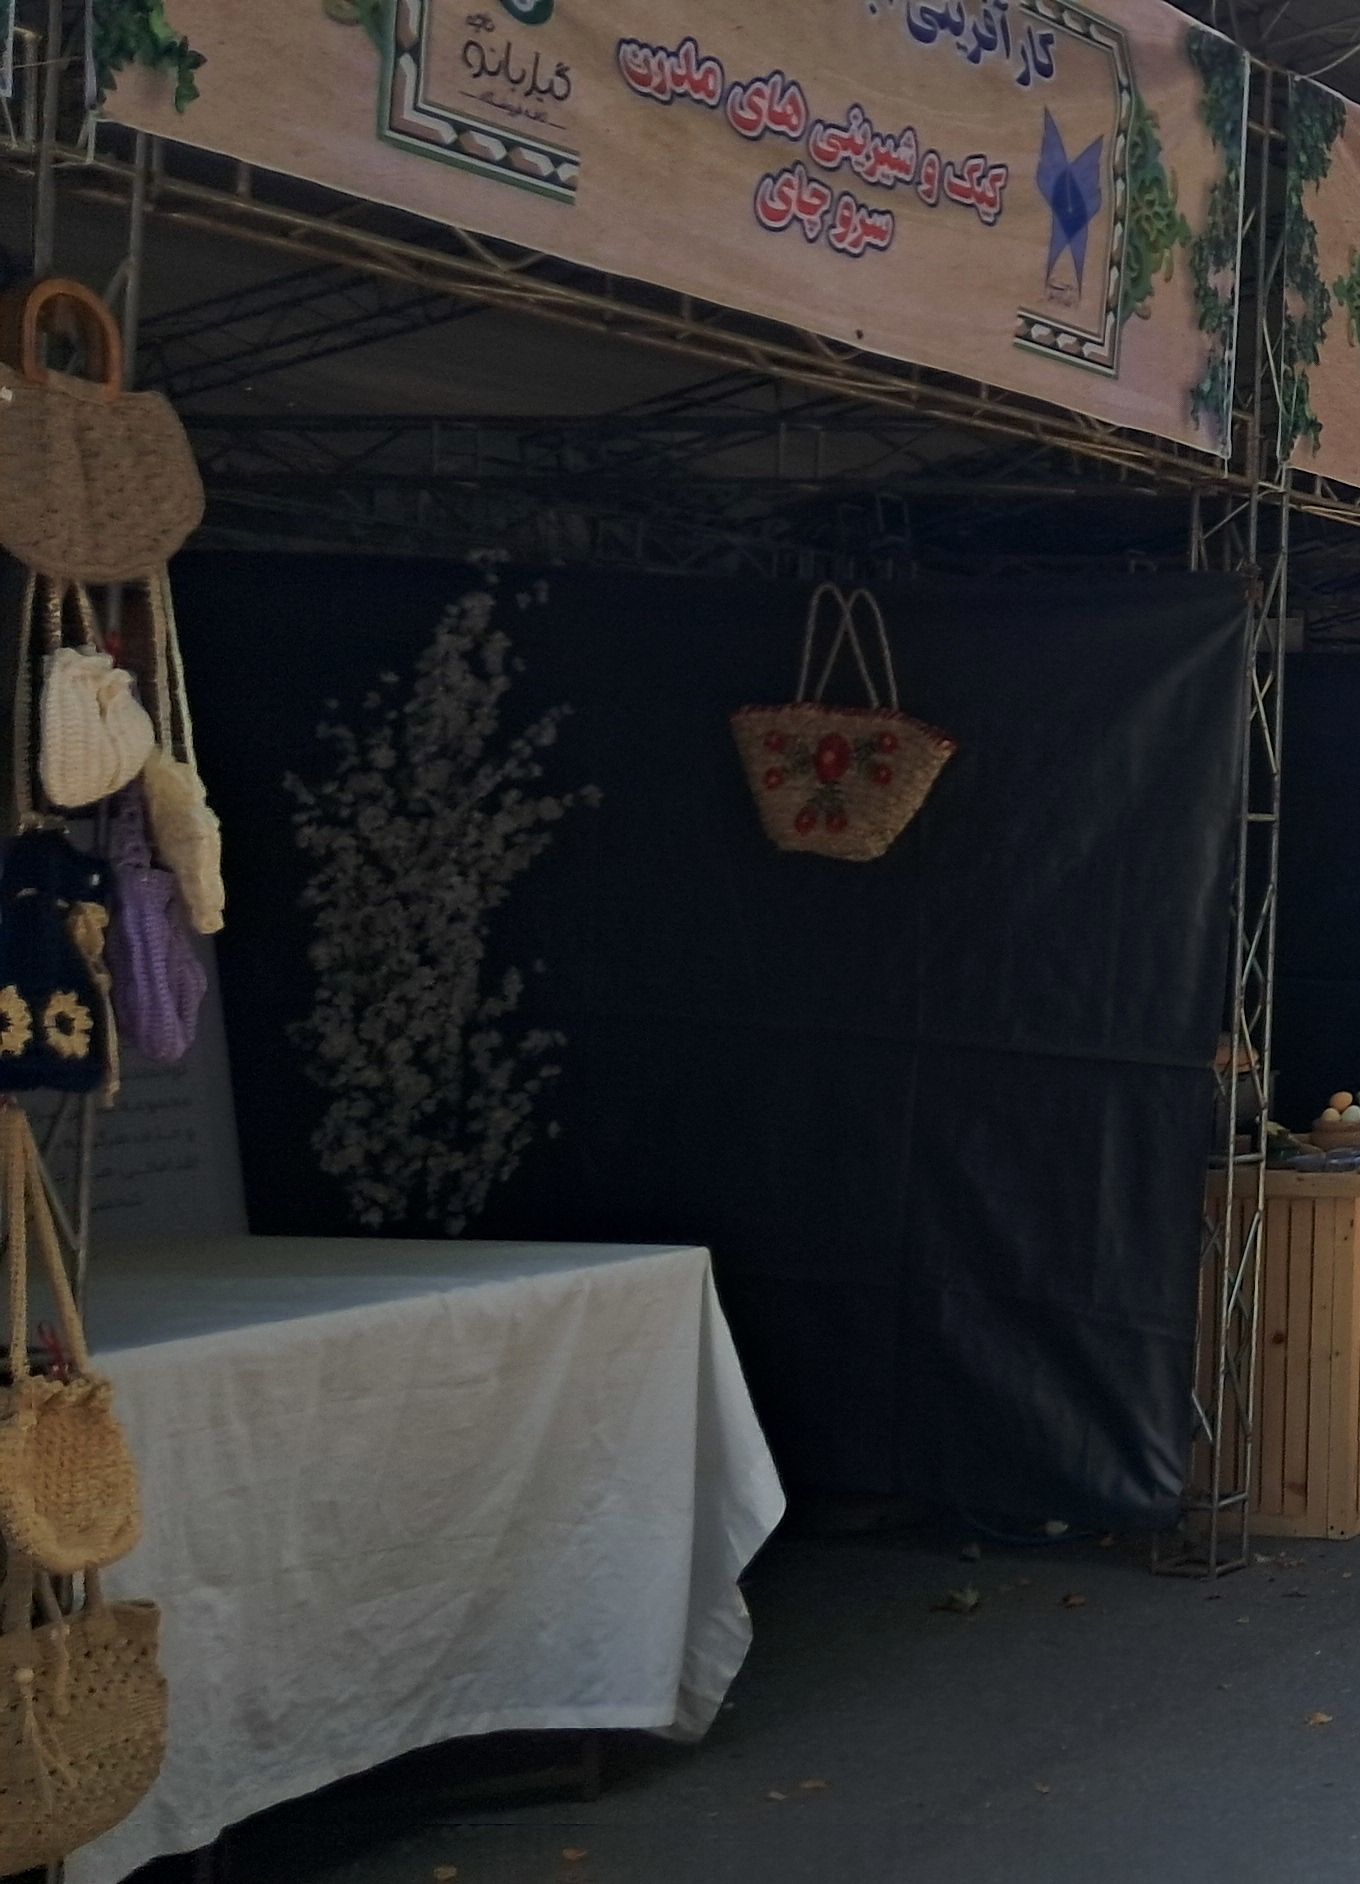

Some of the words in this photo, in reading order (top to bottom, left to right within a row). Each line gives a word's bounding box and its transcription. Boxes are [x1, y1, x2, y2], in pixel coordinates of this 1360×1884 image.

[615, 36, 725, 108] مدرن
[726, 69, 809, 140] های
[809, 103, 919, 188] شیرینی
[918, 148, 941, 207] و
[755, 160, 832, 243] چای
[828, 190, 895, 257] سرو
[944, 153, 1009, 226] کیک
